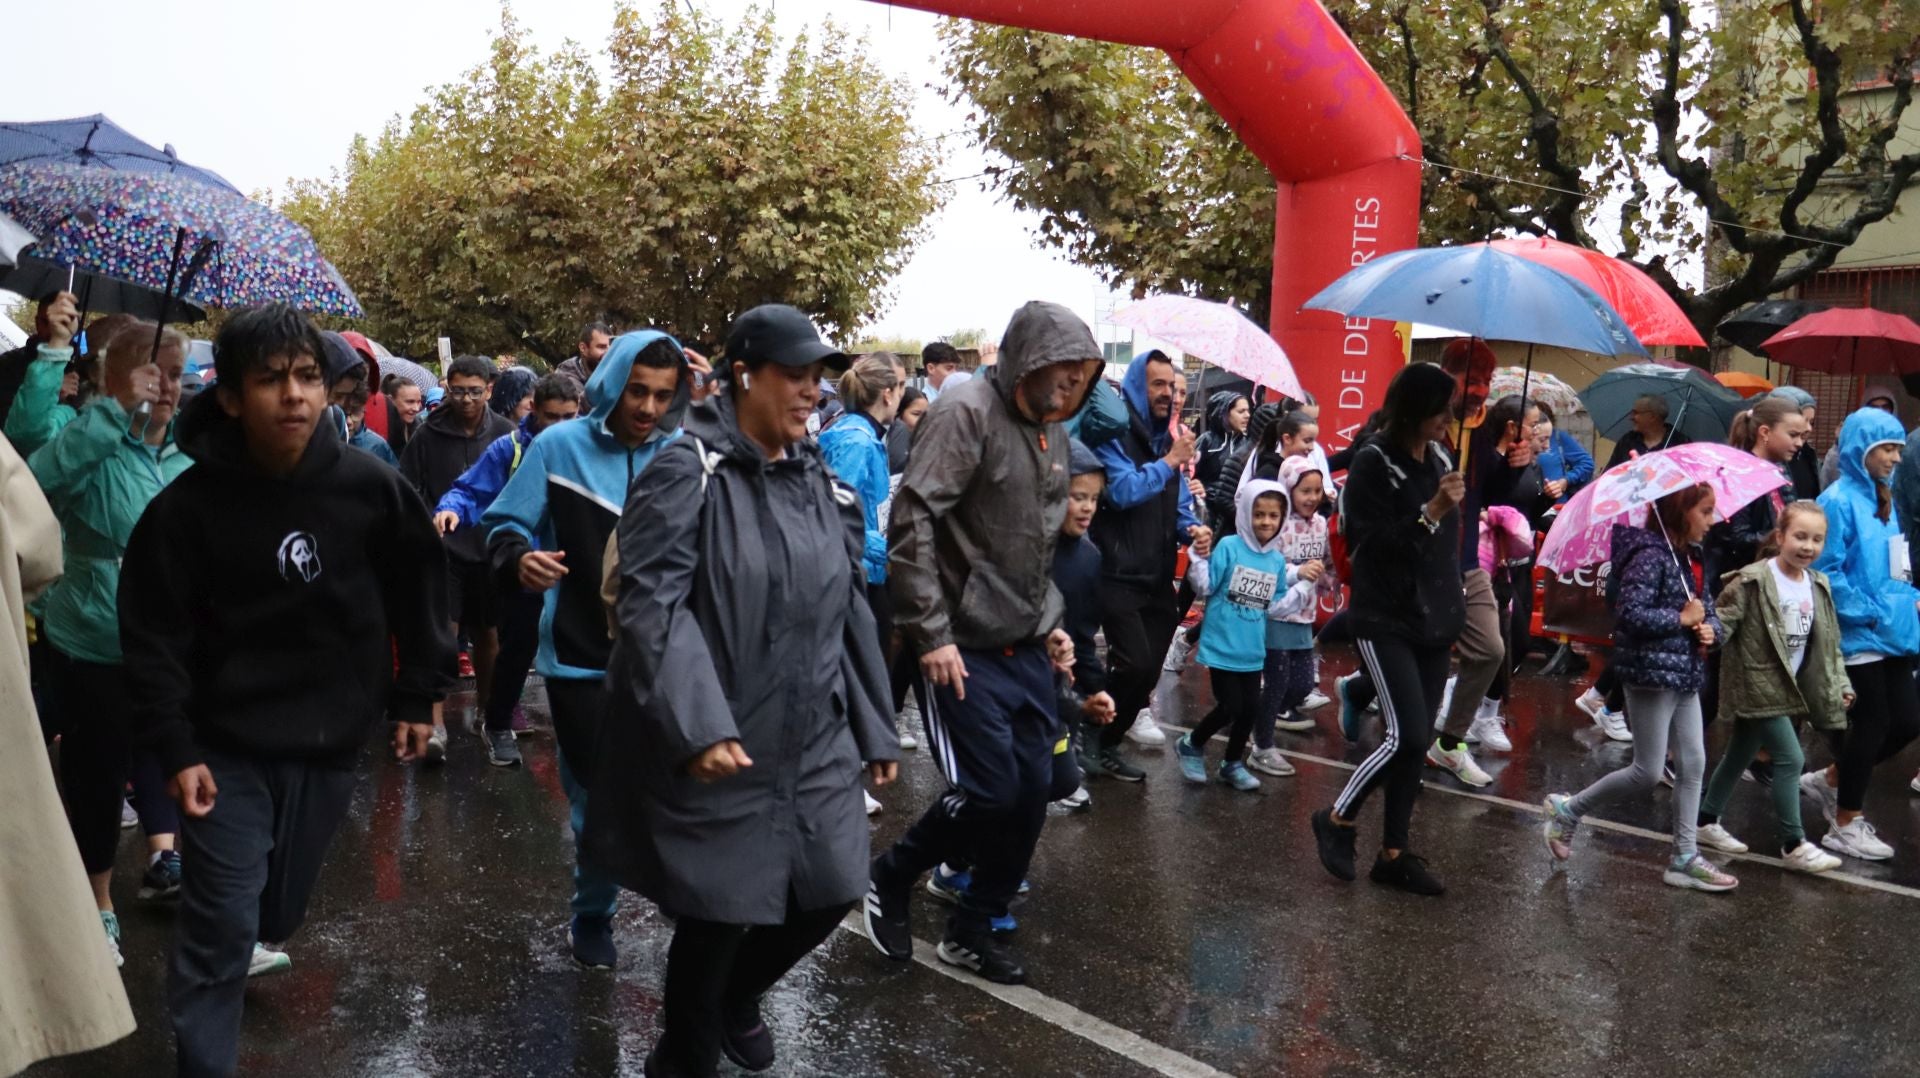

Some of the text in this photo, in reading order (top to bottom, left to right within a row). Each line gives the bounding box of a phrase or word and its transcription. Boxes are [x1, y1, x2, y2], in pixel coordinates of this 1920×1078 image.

[1339, 370, 1366, 409] DE
[1300, 542, 1323, 559] 3252
[1239, 577, 1271, 599] 3239
